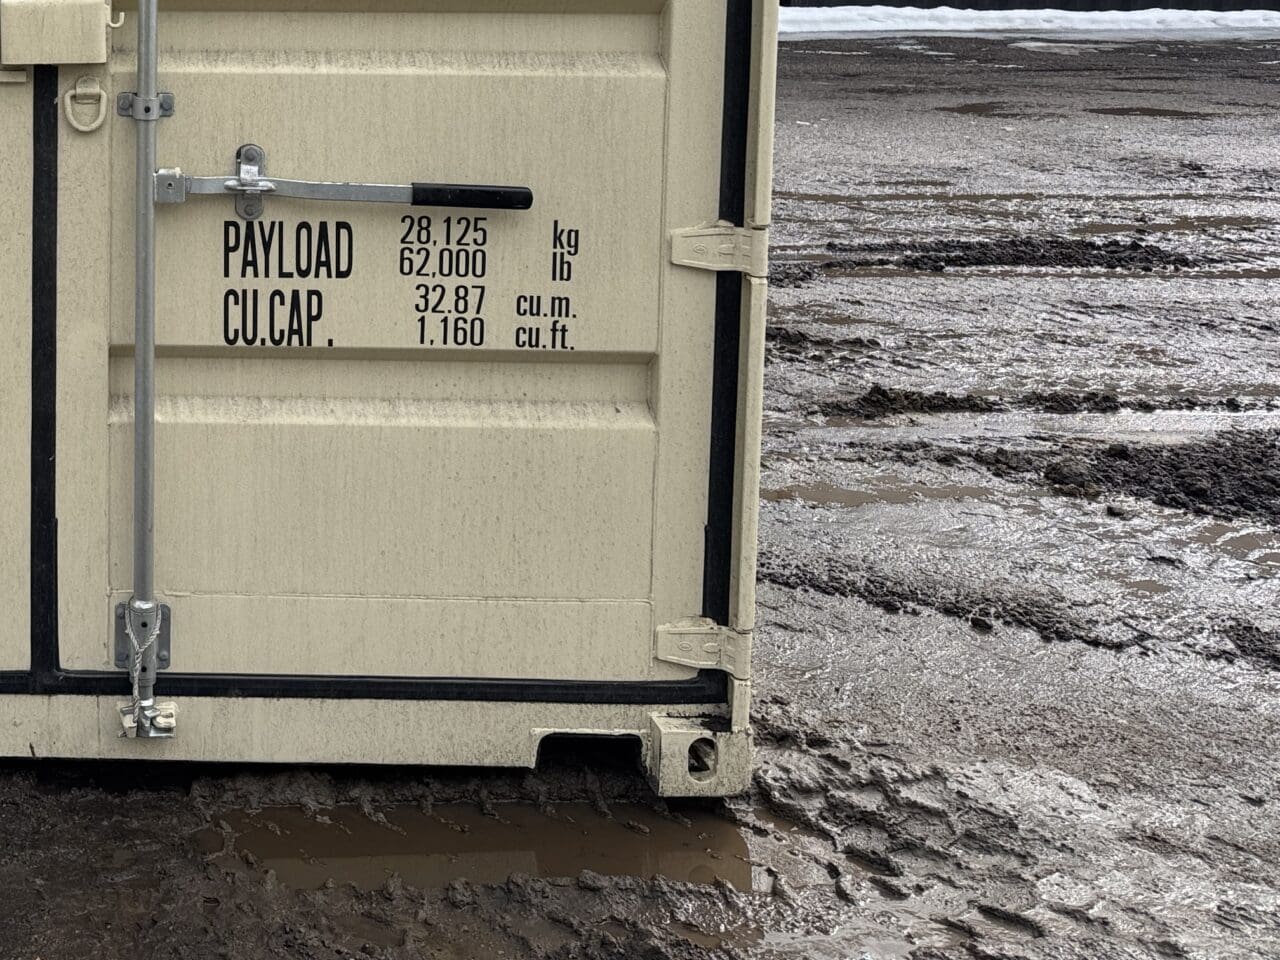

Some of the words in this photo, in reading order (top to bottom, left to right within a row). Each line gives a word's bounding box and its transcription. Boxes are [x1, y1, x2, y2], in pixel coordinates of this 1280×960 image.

[223, 220, 354, 279] PAYLOAD
[399, 215, 488, 248] 28,125
[551, 219, 580, 256] kg
[398, 247, 487, 279] 62,000
[551, 250, 572, 282] lb
[414, 285, 486, 315] 32.87
[515, 292, 578, 320] cu.m.
[416, 316, 485, 347] 1,160
[515, 321, 576, 351] cu.ft.
